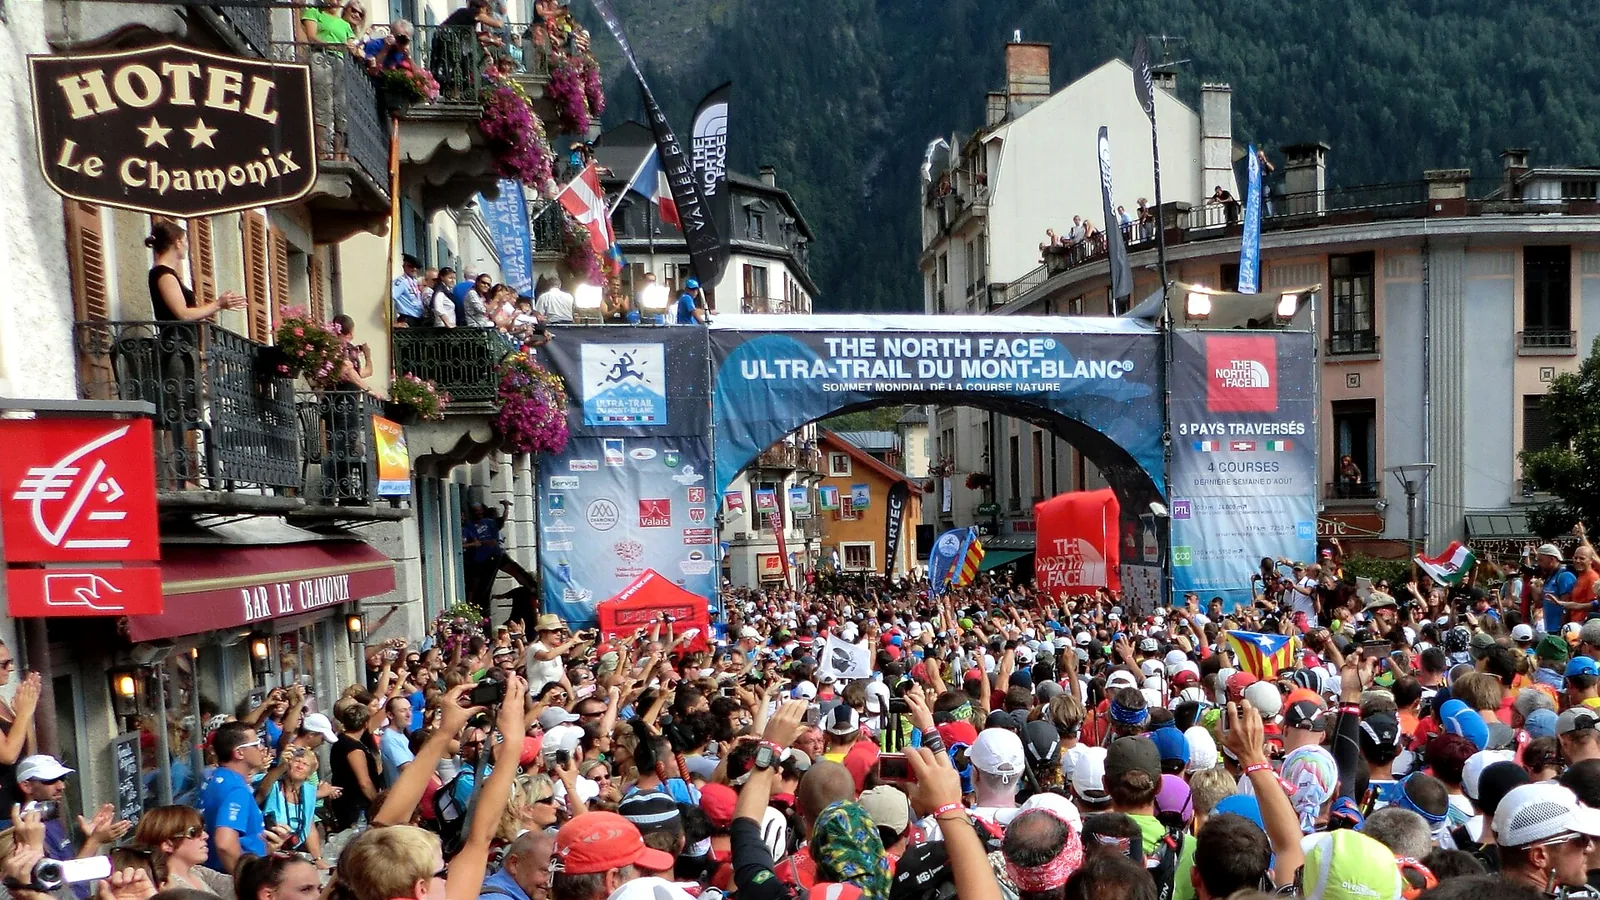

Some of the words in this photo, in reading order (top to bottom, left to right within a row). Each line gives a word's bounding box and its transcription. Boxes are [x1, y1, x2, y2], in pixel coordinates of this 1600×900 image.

[57, 62, 279, 125] HOTEL
[693, 137, 705, 172] THE
[715, 135, 727, 178] FACE
[57, 138, 104, 178] Le
[120, 147, 301, 196] Chamonix
[704, 136, 716, 197] NORTH
[824, 337, 876, 357] THE
[884, 337, 971, 358] NORTH
[741, 359, 912, 379] ULTRA-TRAIL
[919, 359, 953, 379] DU
[1231, 360, 1250, 369] THE
[1215, 369, 1251, 379] NORTH
[823, 382, 872, 392] SOMMET
[875, 382, 926, 392] MONDIAL
[930, 383, 944, 391] DE
[948, 383, 962, 391] LA
[966, 383, 1012, 392] COURSE
[1016, 383, 1060, 392] NATURE
[1226, 378, 1251, 388] FACE
[596, 399, 654, 408] ULTRA-TRAIL
[1179, 423, 1188, 435] 3
[1191, 423, 1225, 435] PAYS
[1228, 420, 1305, 435] TRAVERSÉS
[1207, 462, 1215, 473] 4
[1218, 462, 1280, 473] COURSES
[1174, 506, 1189, 515] PTL
[641, 517, 669, 526] Valais
[886, 498, 902, 571] OLARTEC
[1053, 538, 1080, 555] THE
[1037, 555, 1084, 572] NORTH
[1047, 570, 1081, 587] FACE
[241, 586, 271, 621] BAR
[276, 583, 294, 613] LE
[299, 574, 350, 610] CHAMONIX
